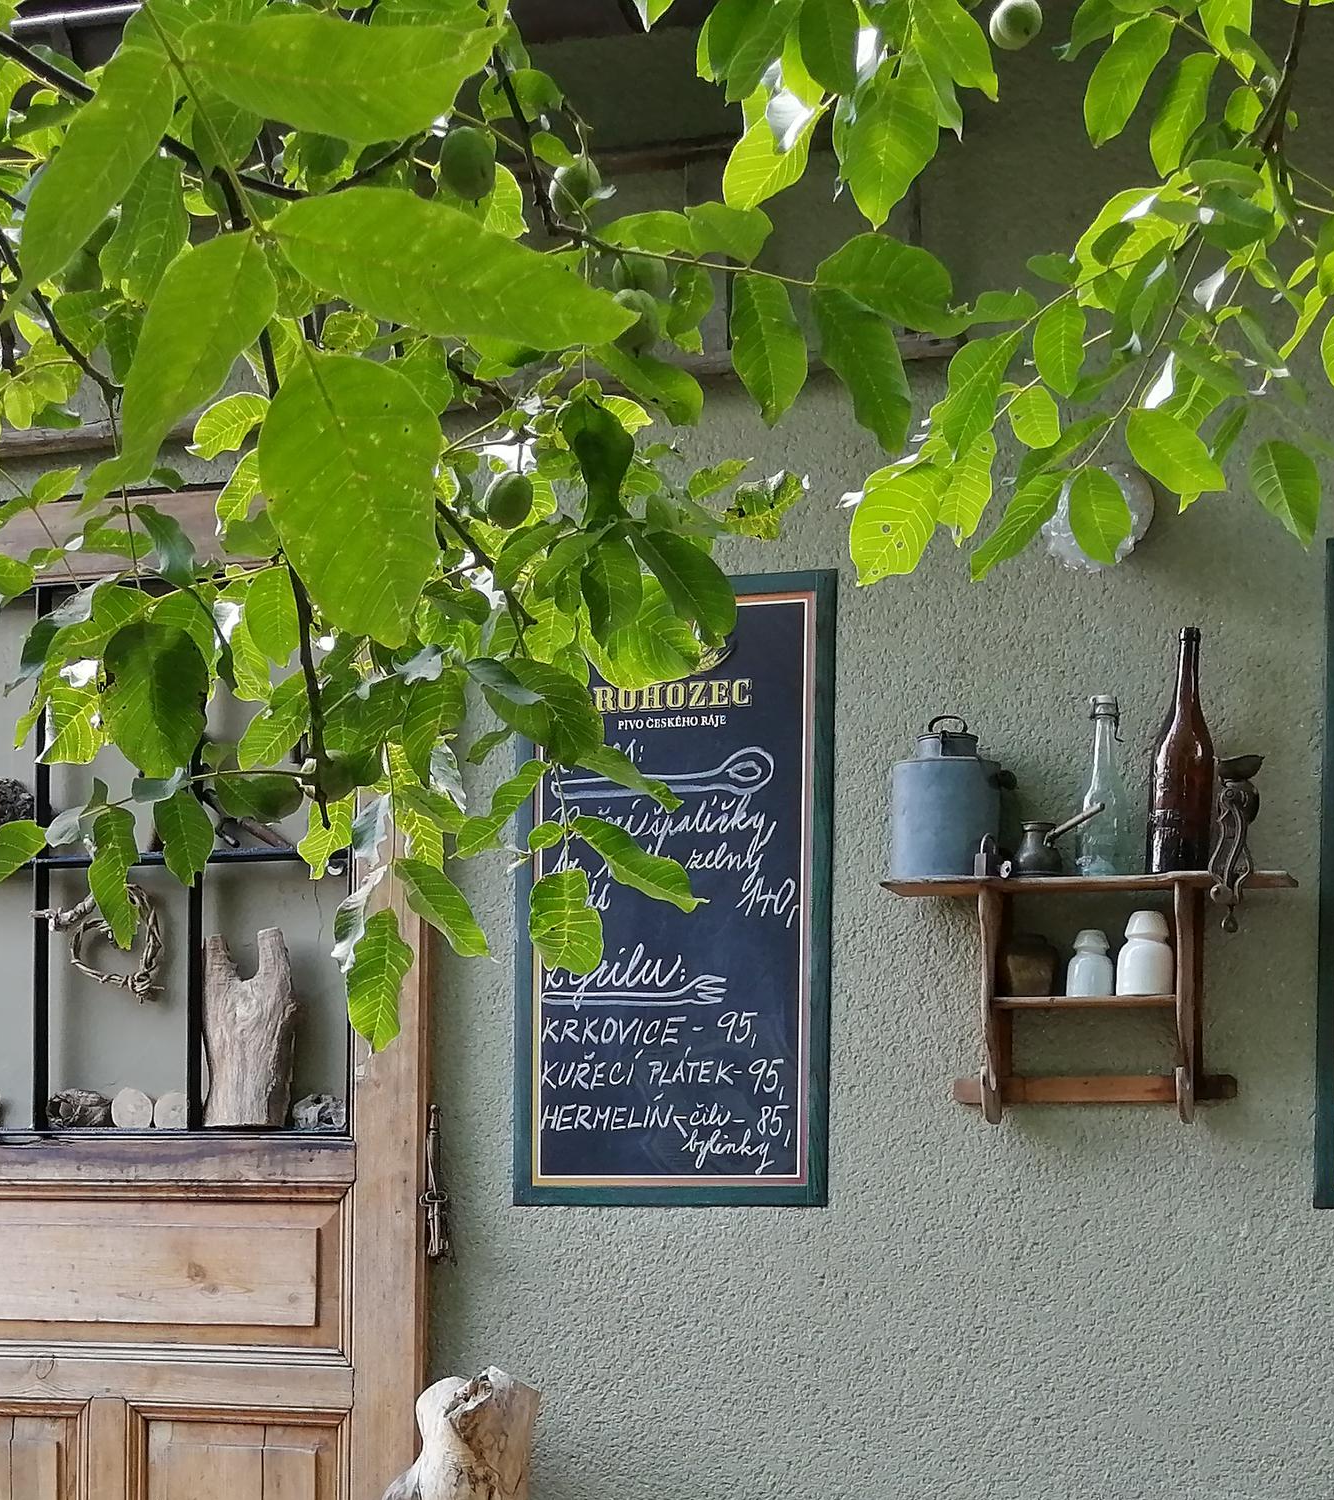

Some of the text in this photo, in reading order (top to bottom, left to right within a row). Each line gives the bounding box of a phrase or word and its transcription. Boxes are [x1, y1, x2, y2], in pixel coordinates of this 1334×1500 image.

[594, 678, 753, 716] ROHOZEC
[618, 714, 727, 731] PIVO ČESKÉHO RÁJE
[541, 1015, 687, 1047] KRKOVICE
[541, 1049, 645, 1091] KUŘECÍ
